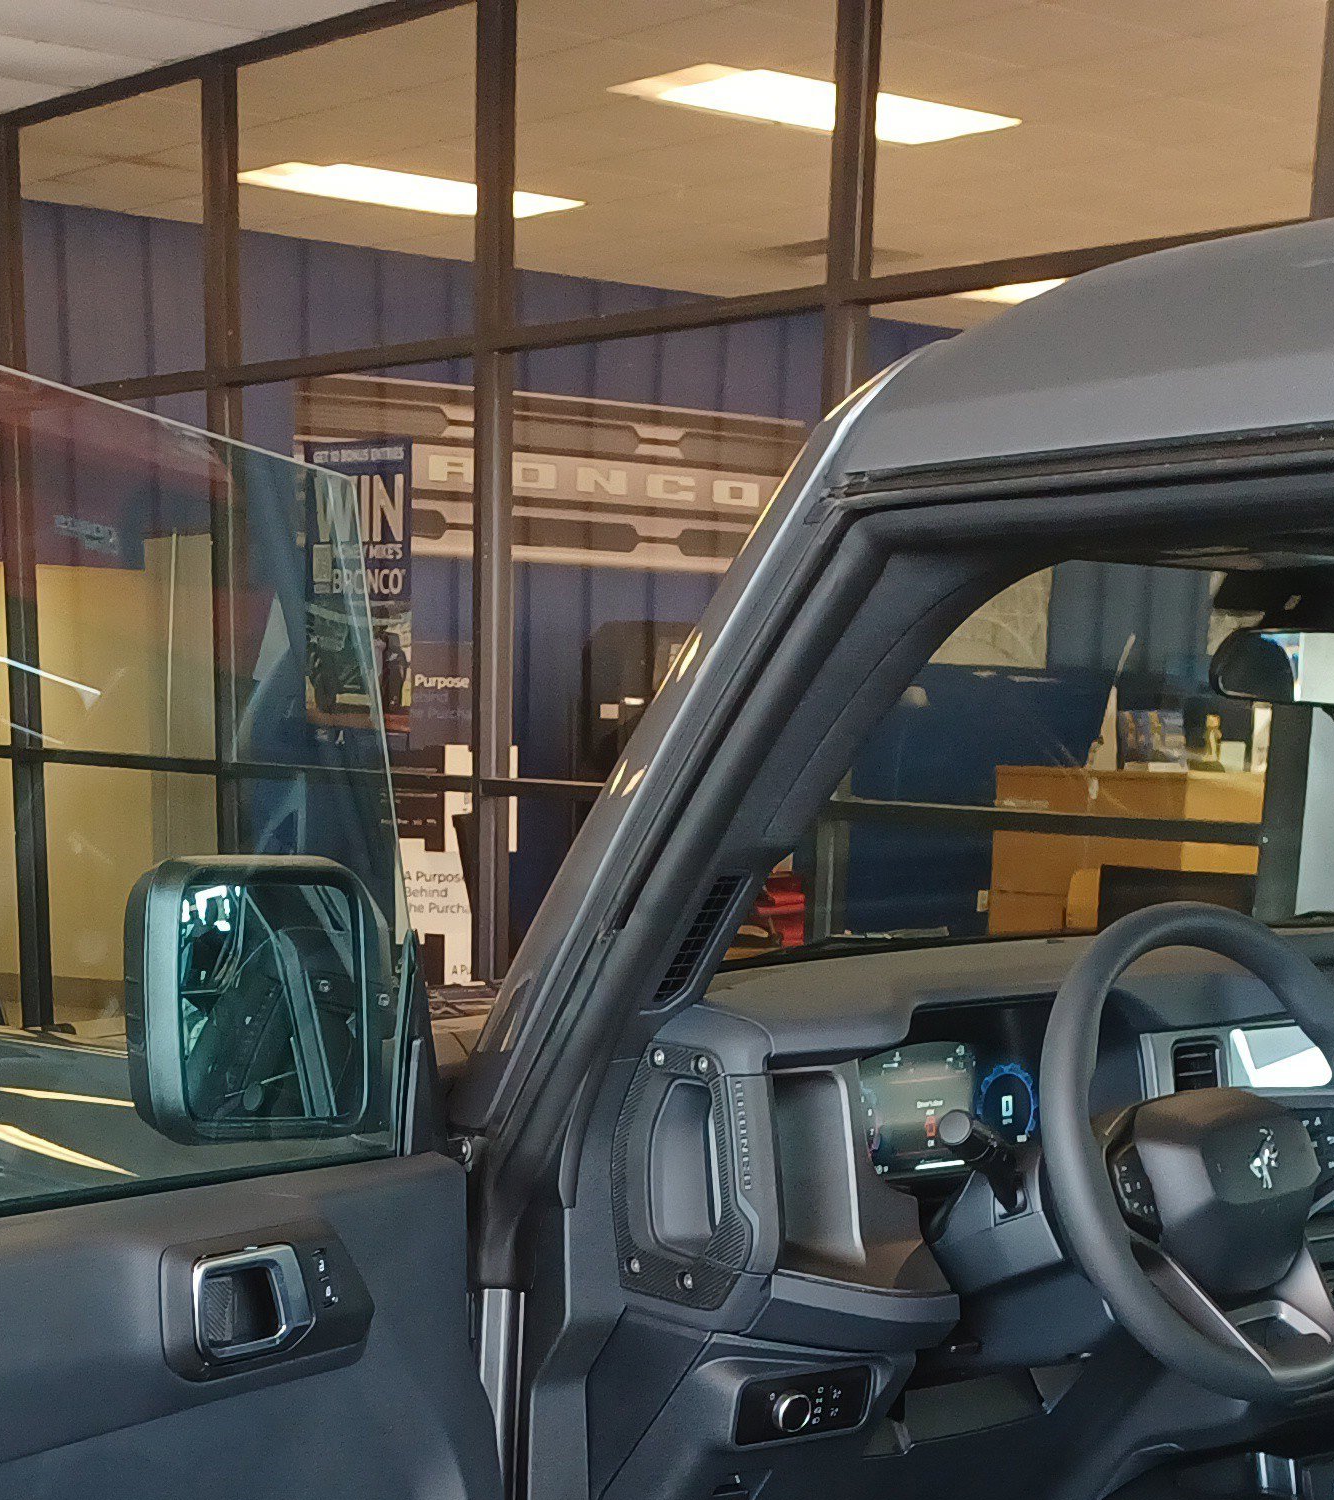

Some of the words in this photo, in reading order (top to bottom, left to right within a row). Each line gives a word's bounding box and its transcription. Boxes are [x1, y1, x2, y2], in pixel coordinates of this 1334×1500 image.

[428, 454, 760, 508] RONCO
[314, 473, 404, 542] WIN
[332, 568, 402, 595] BRONCO
[414, 673, 470, 689] Purpose
[409, 902, 424, 913] he
